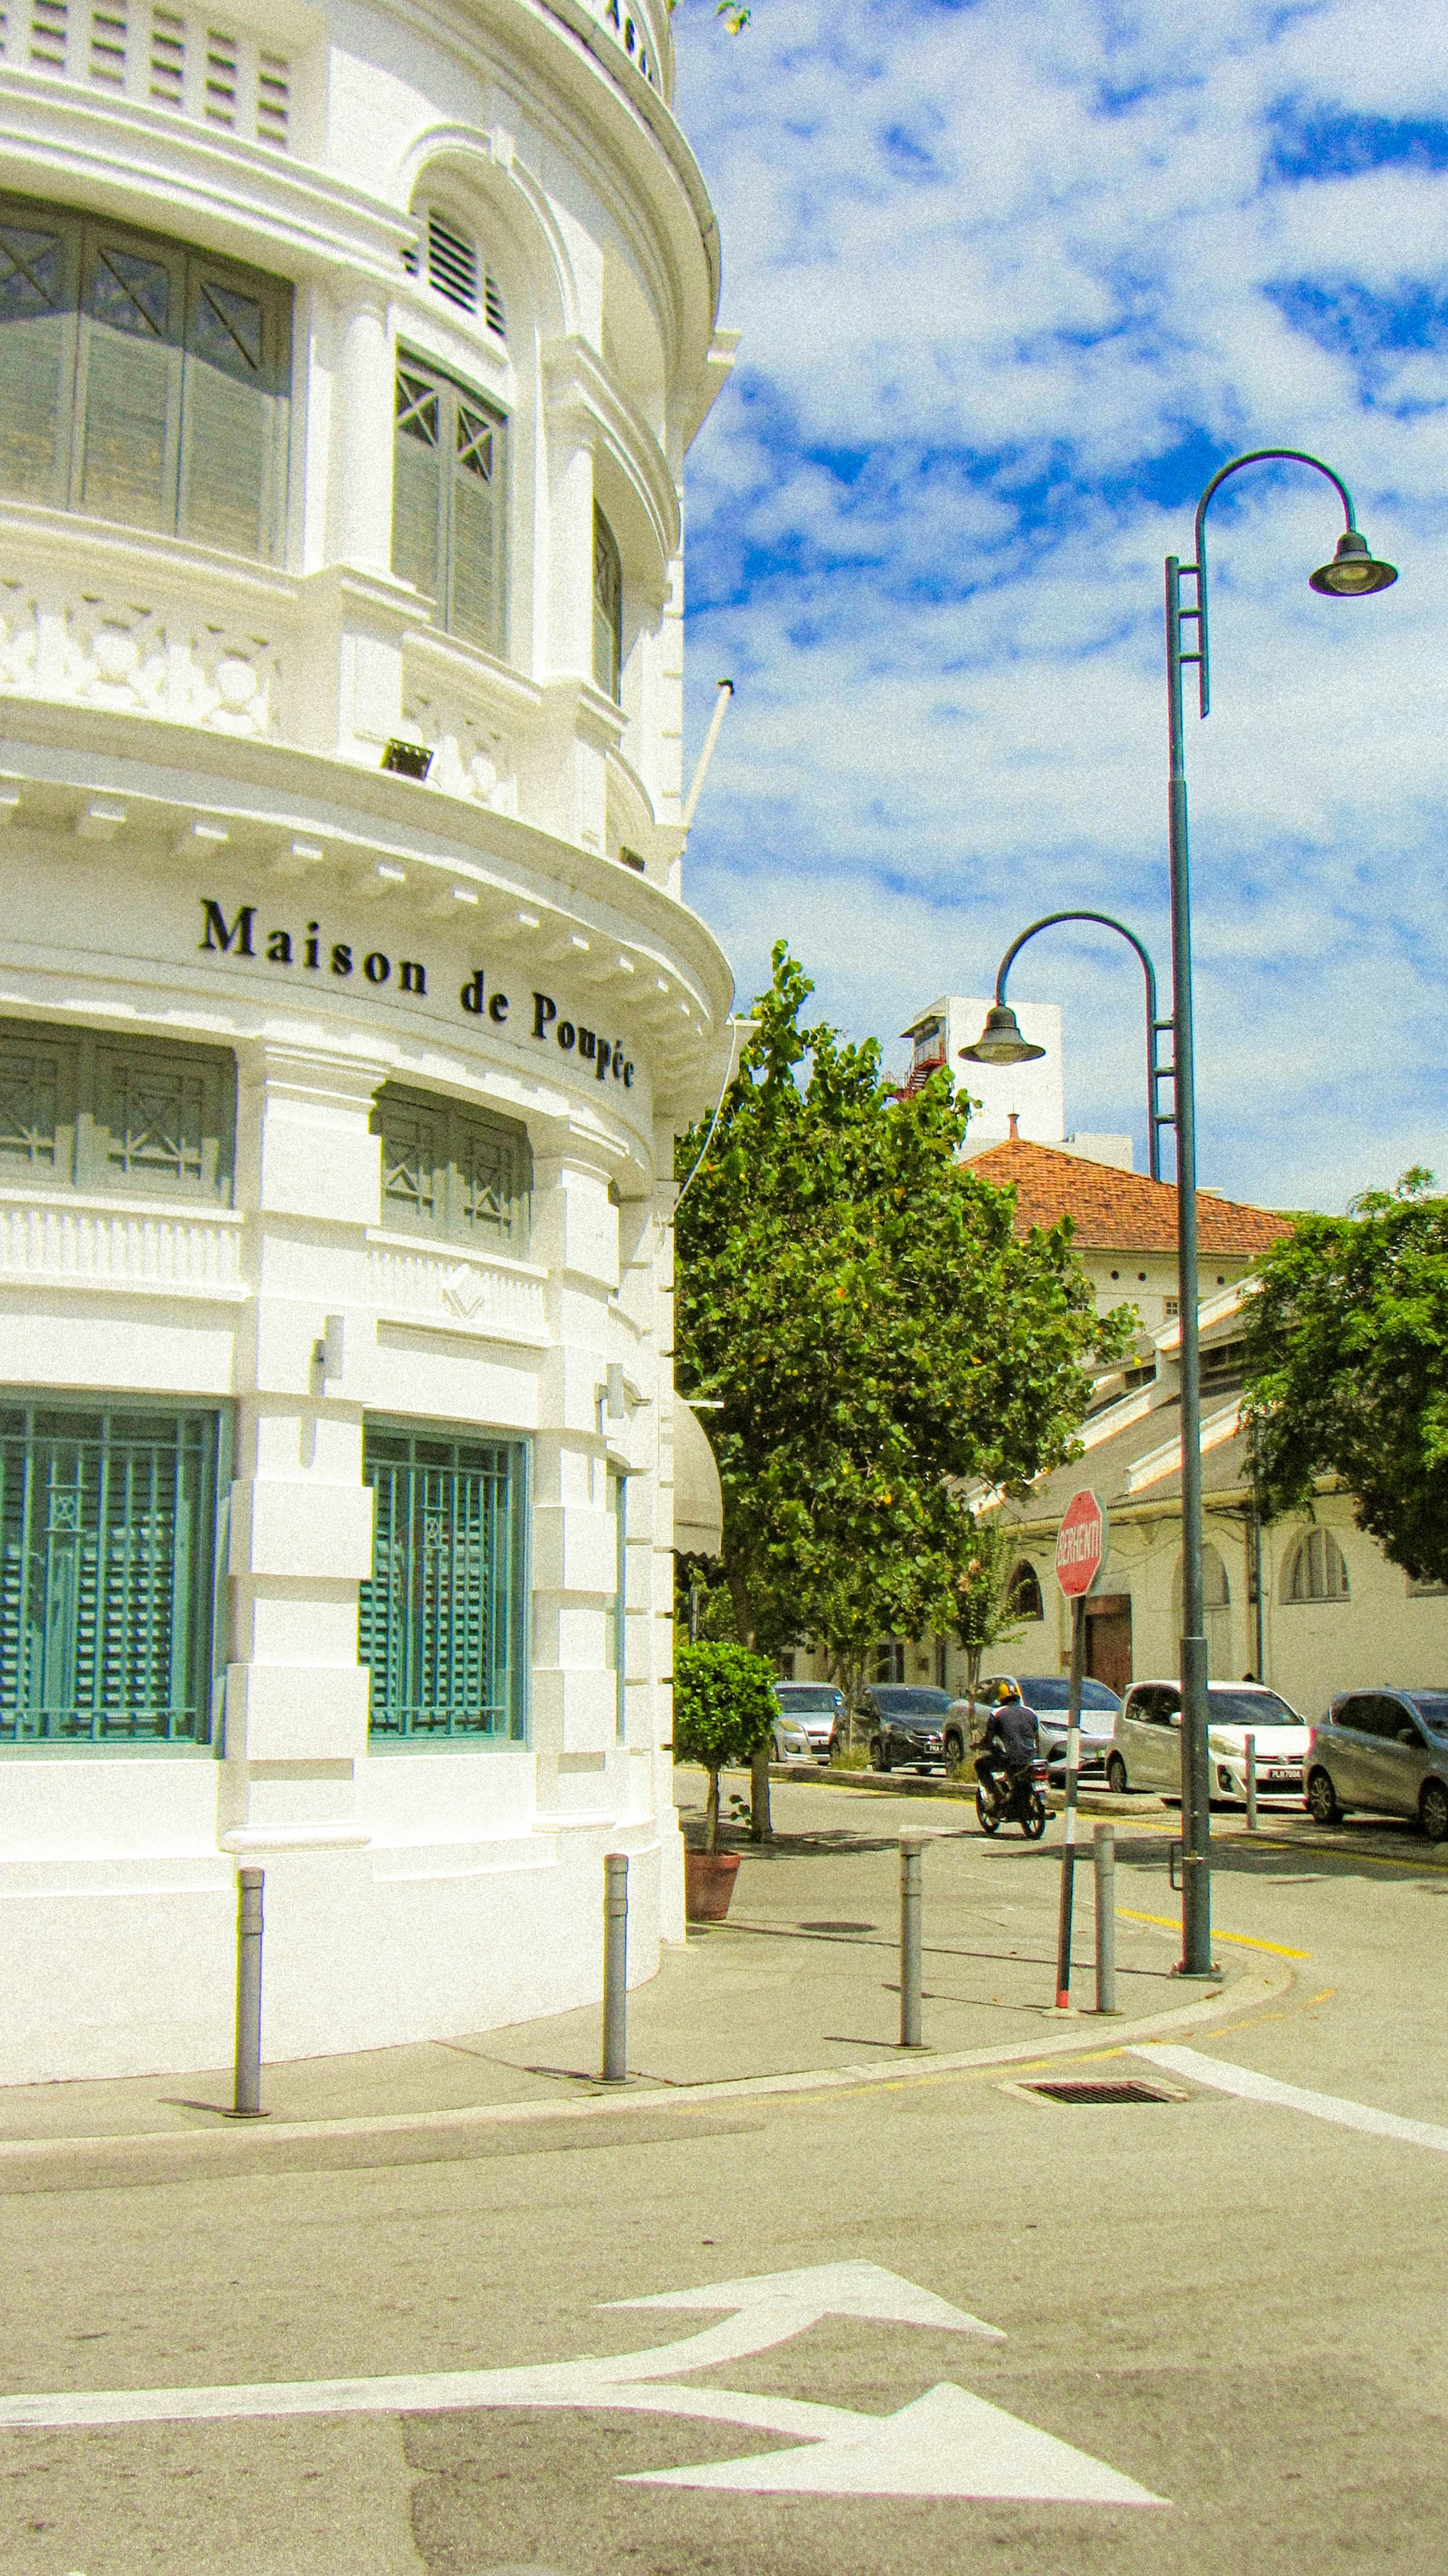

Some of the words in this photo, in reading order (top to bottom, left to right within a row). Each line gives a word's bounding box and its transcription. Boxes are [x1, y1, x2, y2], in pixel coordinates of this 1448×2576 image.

[198, 897, 427, 995] Maison
[459, 970, 509, 1022] de
[530, 992, 634, 1088] Poupée
[1058, 1520, 1099, 1566] BERHENTI
